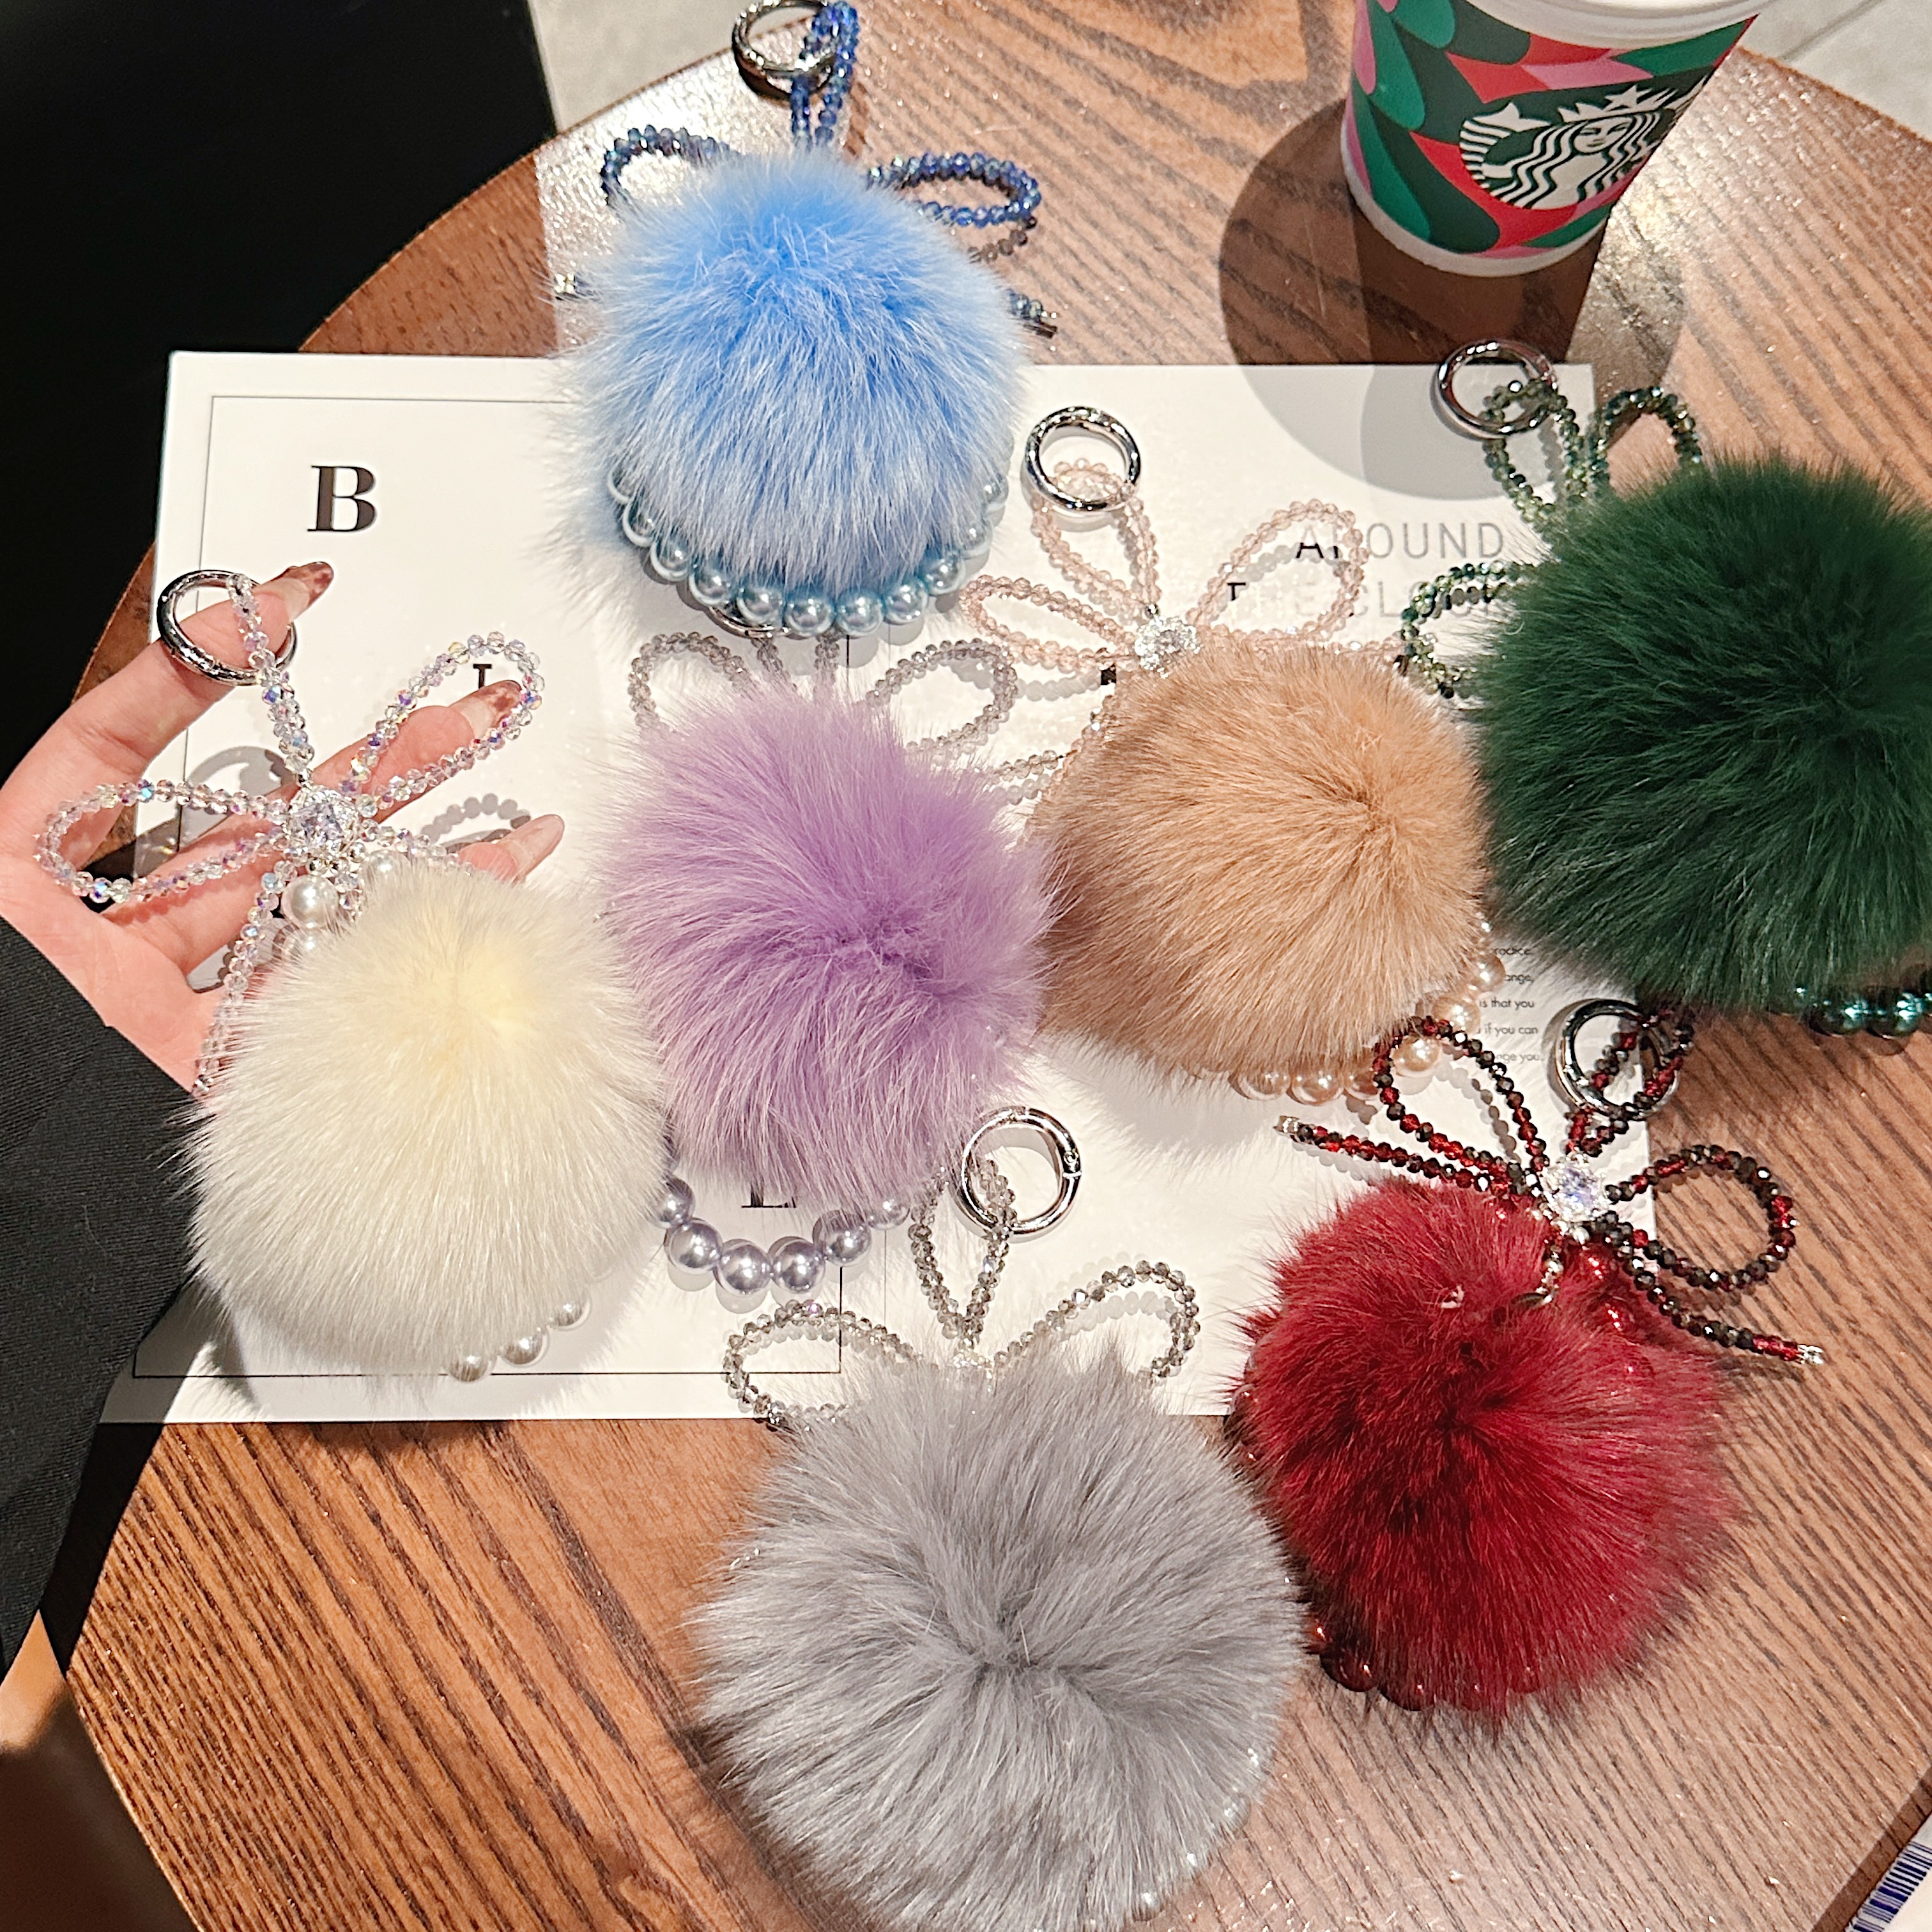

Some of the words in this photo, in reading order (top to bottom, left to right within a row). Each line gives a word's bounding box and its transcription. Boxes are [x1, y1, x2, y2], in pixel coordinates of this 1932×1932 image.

[307, 465, 377, 532] B
[1491, 997, 1511, 1008] that
[1514, 1000, 1535, 1010] you
[1495, 1027, 1515, 1036] you
